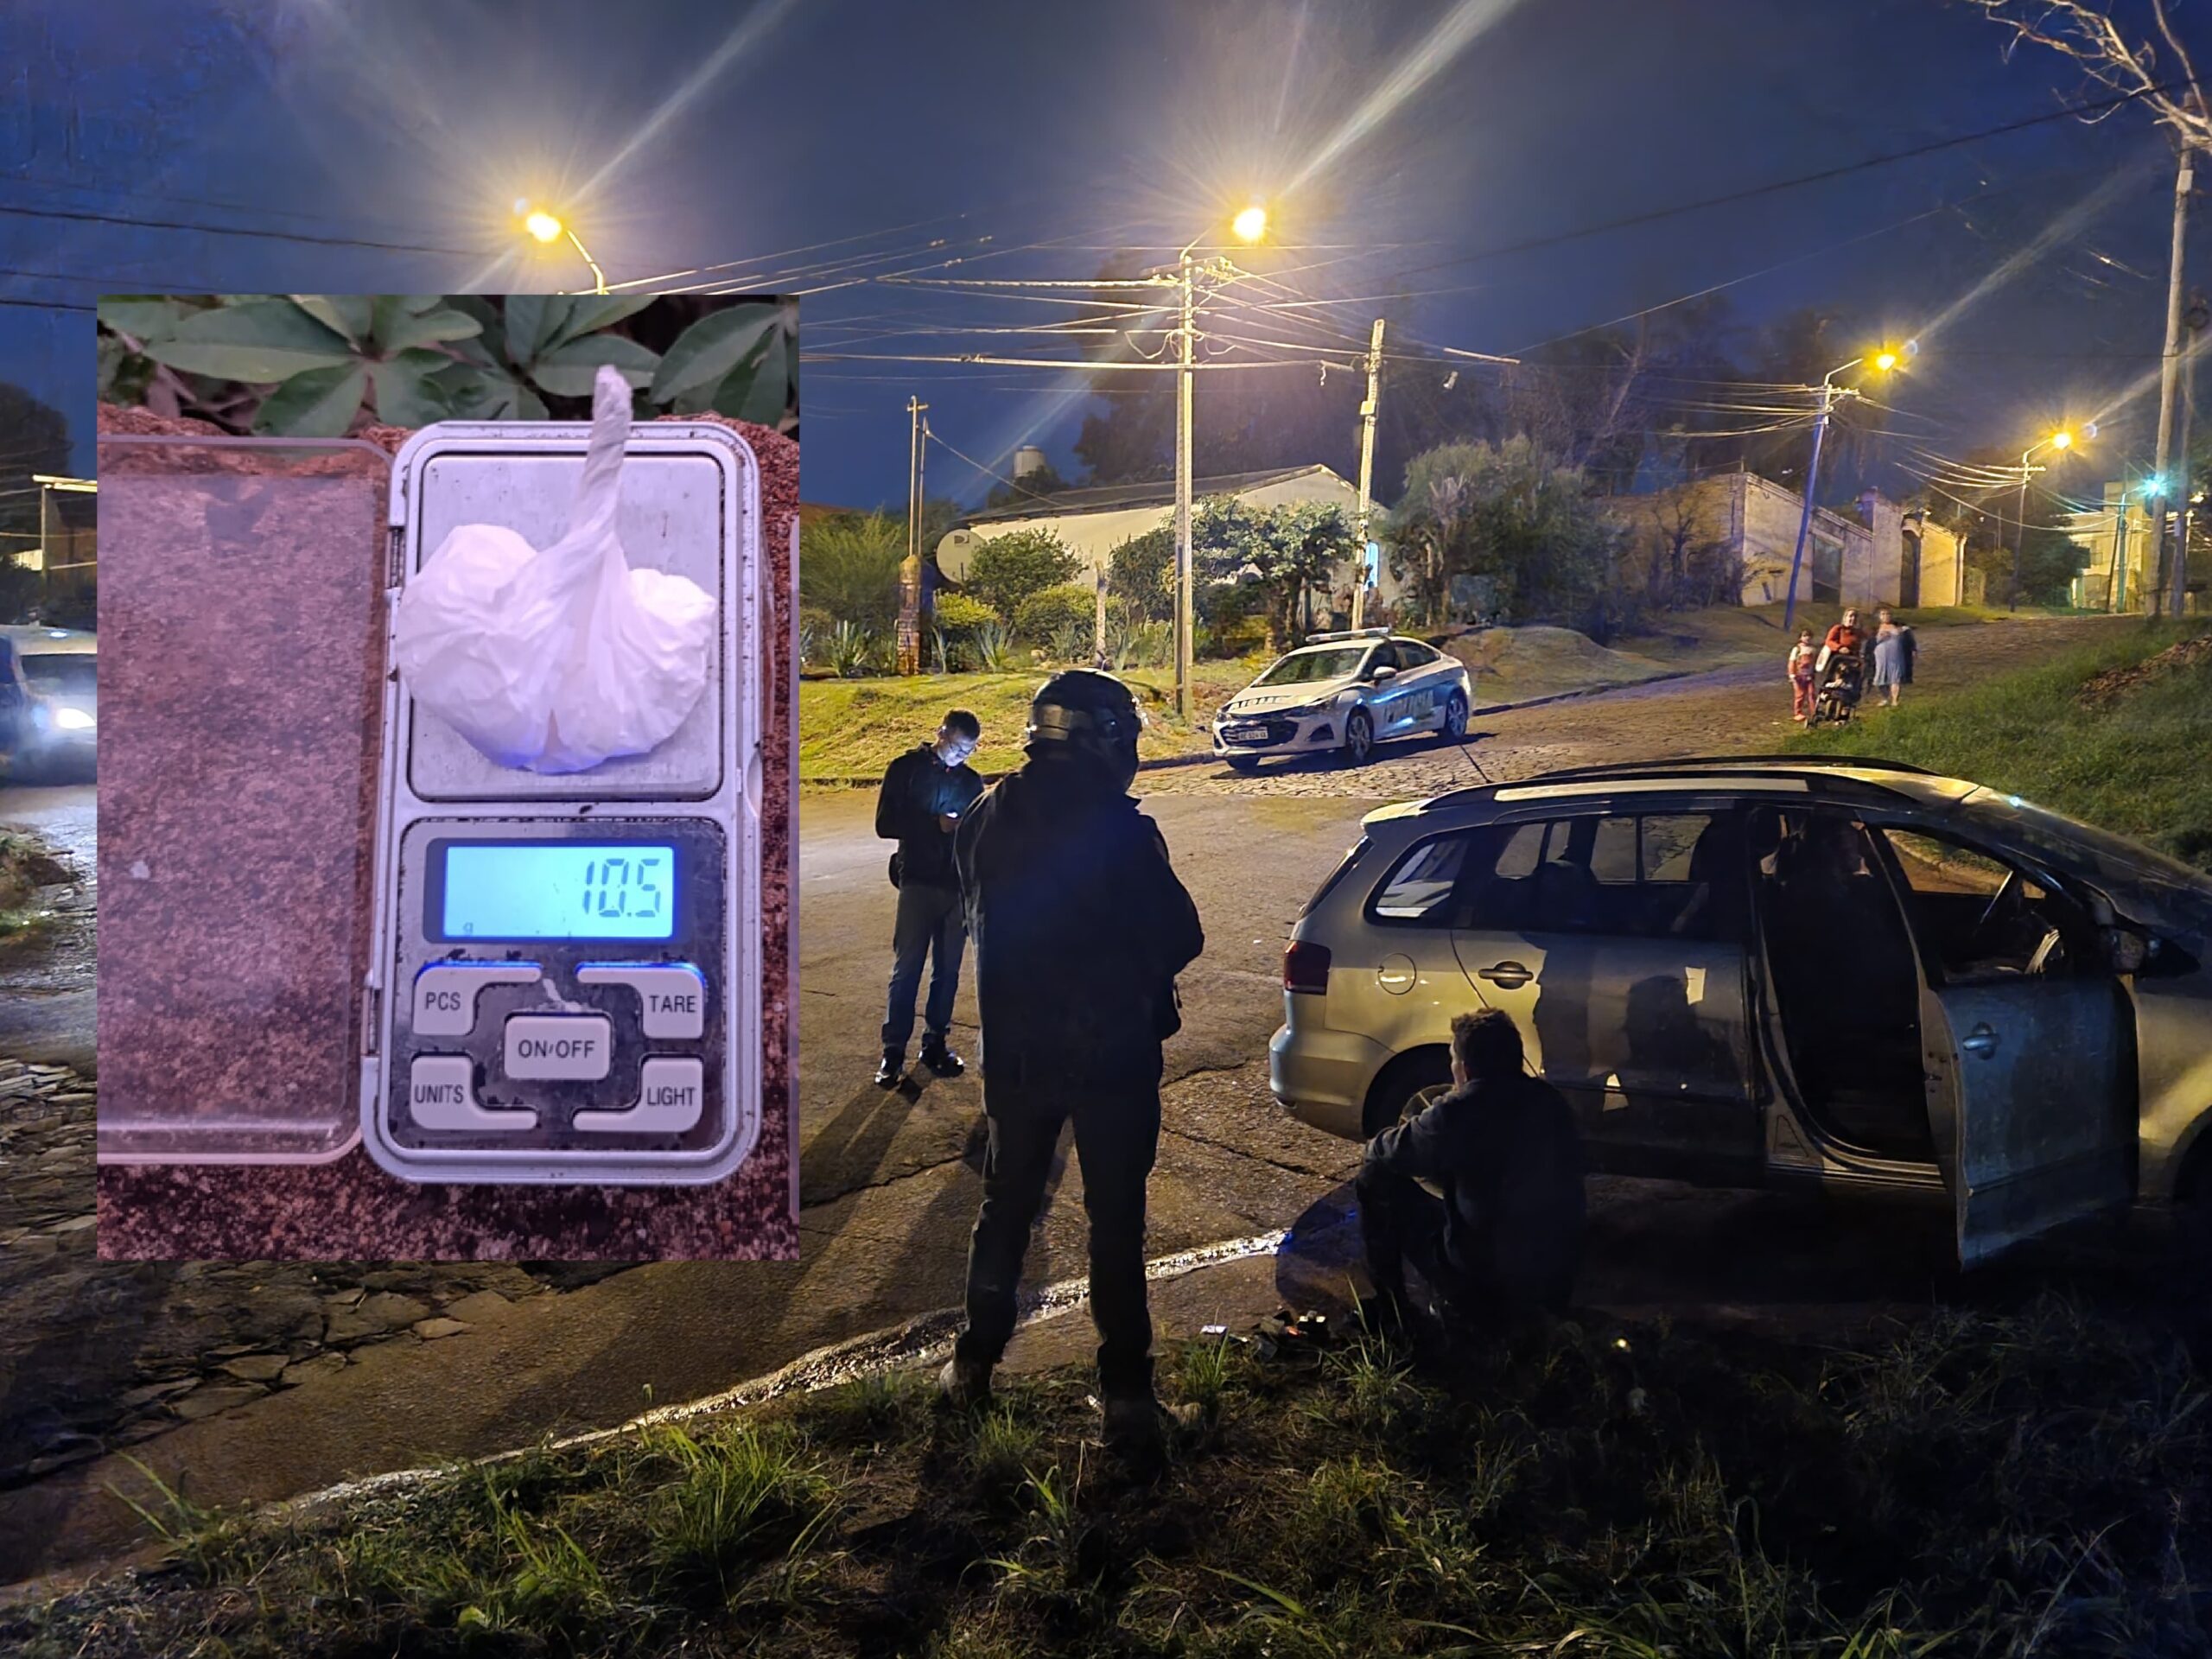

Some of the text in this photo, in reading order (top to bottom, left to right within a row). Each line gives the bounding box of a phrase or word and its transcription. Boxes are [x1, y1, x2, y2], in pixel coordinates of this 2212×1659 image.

[582, 858, 661, 918] 10.5
[424, 992, 461, 1011] PCS
[649, 995, 697, 1013] TARE
[518, 1039, 595, 1058] ON/OFF
[414, 1084, 464, 1103] UNITS
[647, 1086, 696, 1106] LIGHT
